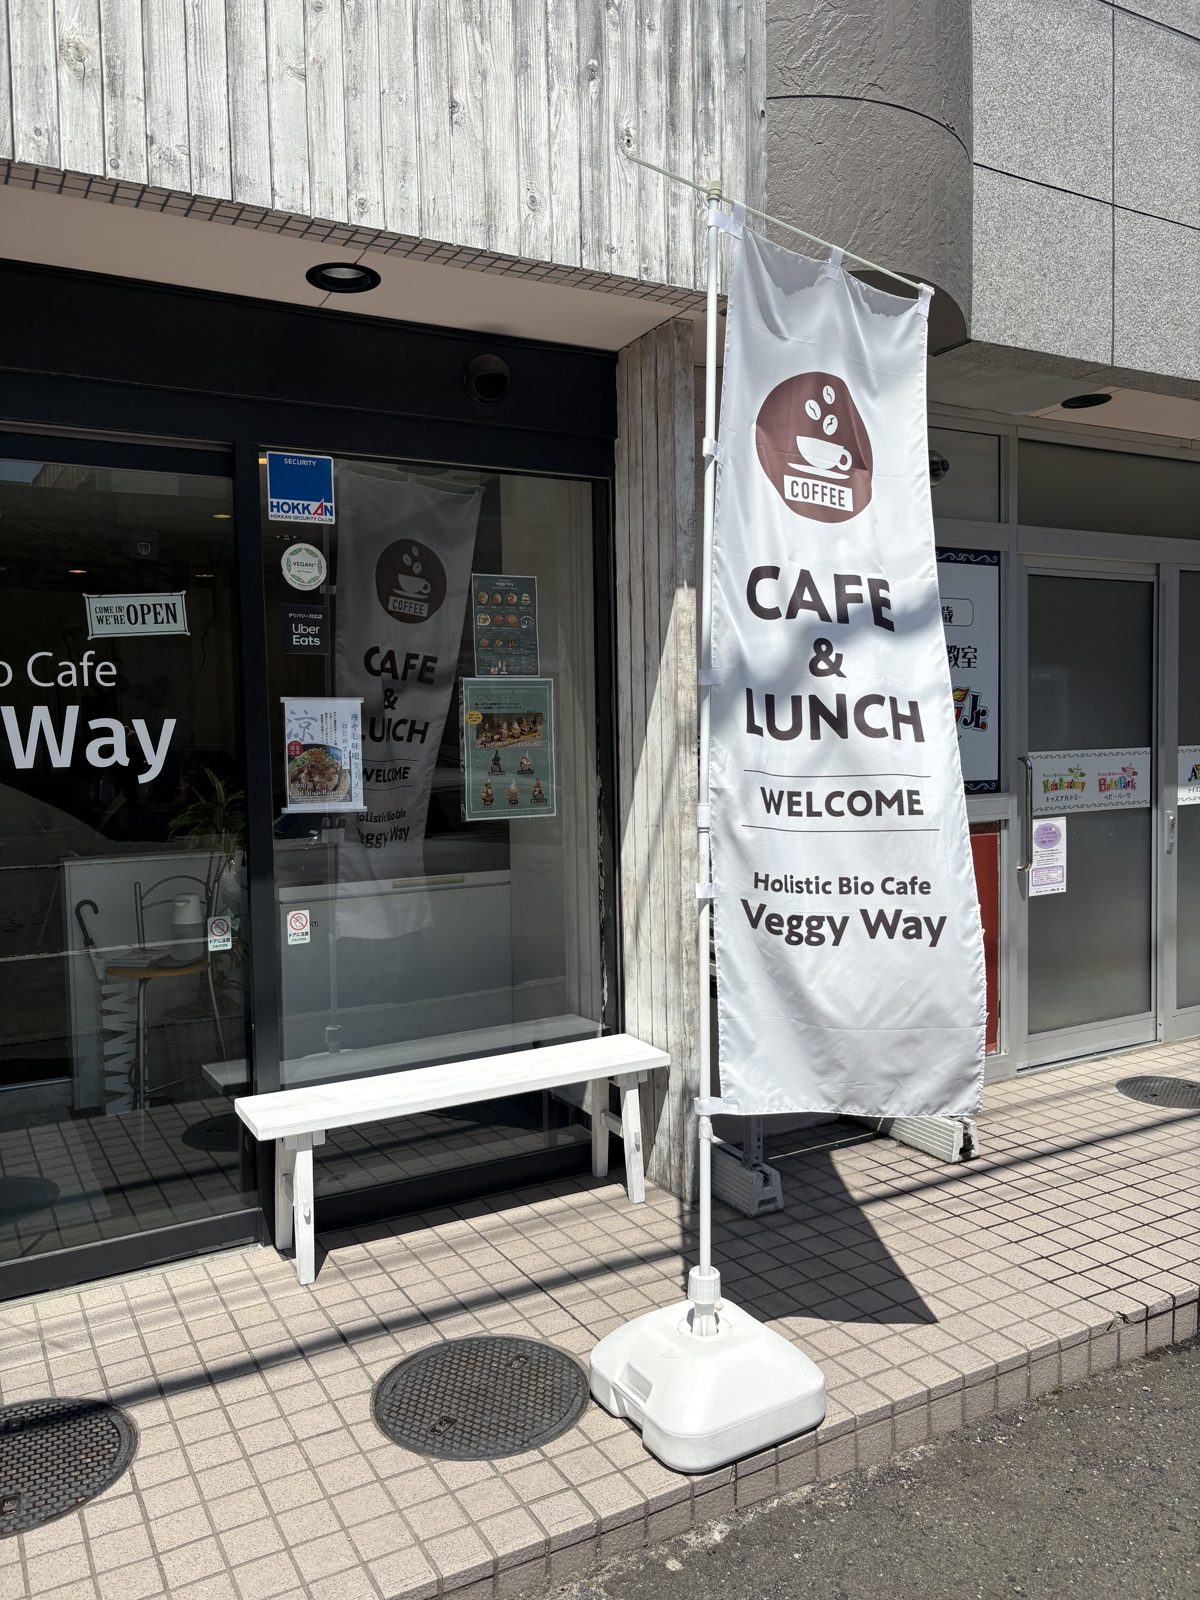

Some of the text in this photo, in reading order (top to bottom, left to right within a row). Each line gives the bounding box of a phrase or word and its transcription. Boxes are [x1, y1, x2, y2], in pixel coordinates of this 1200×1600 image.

[284, 458, 317, 467] SECURITY
[270, 499, 334, 517] HOKKAN
[790, 480, 846, 508] COFFEE
[94, 606, 125, 614] COME IN!
[392, 599, 425, 615] COFFEE
[746, 565, 895, 632] CAFE
[95, 614, 126, 625] WE'RE
[126, 602, 178, 626] OPEN
[292, 623, 320, 634] Uber
[292, 635, 321, 646] Eats
[26, 650, 117, 687] Cafe
[363, 645, 439, 686] CAFE
[809, 637, 847, 679] &
[383, 687, 399, 711] &
[286, 709, 318, 743] 涼
[746, 687, 926, 743] LUNCH
[362, 716, 430, 744] UNCH
[0, 705, 177, 784] Way
[341, 723, 350, 767] はじめました
[350, 713, 360, 798] 冷やし味噌ラーメン
[760, 786, 924, 818] WELCOME
[358, 811, 387, 823] olistic
[753, 872, 931, 895] Holistic Bio Cafe
[740, 898, 948, 948] Veggy Way
